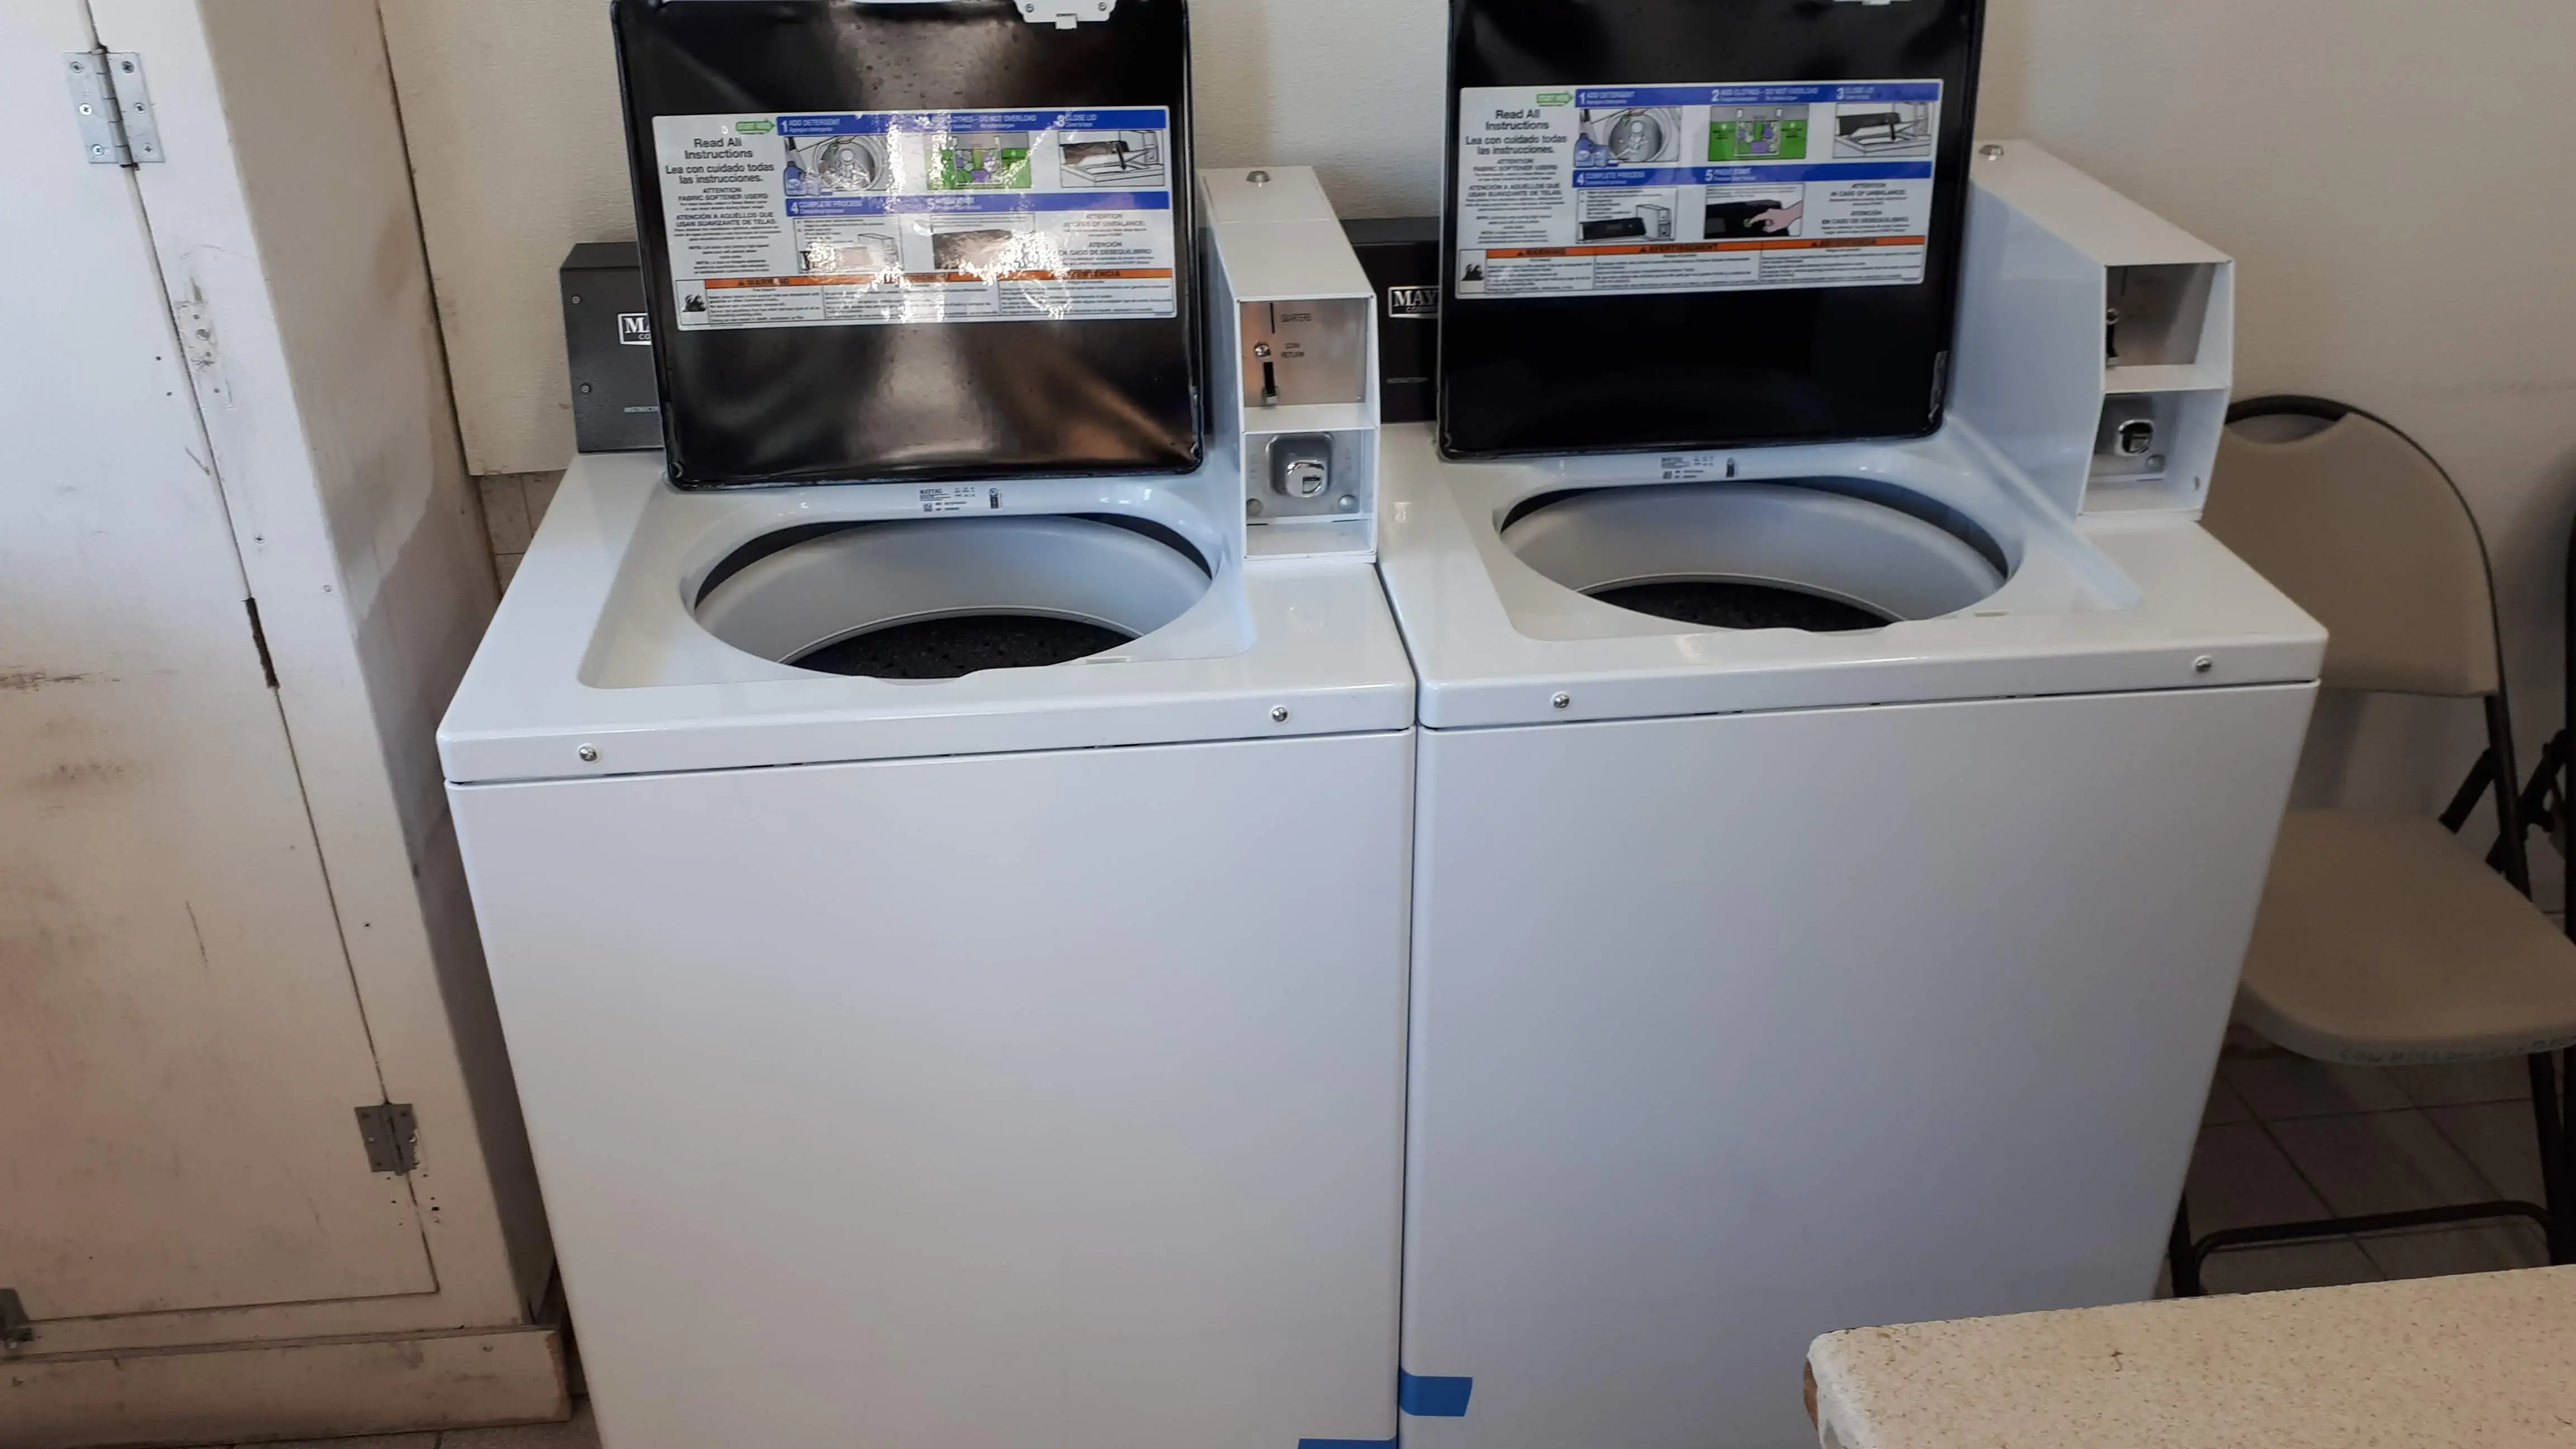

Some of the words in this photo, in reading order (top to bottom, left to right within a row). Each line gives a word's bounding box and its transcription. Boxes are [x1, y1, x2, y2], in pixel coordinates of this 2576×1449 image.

[1578, 91, 1585, 105] 1
[1712, 89, 1720, 102] 2
[1836, 87, 1844, 100] 3
[1495, 110, 1524, 119] Read
[1526, 109, 1541, 118] All
[780, 120, 788, 132] 1
[1485, 121, 1549, 130] Instructions
[694, 138, 724, 148] Read
[727, 137, 742, 146] All
[1465, 136, 1481, 145] Lea
[1504, 135, 1539, 144] cuidado
[1541, 135, 1568, 143] todas
[685, 149, 753, 159] Instructions
[665, 165, 683, 174] Lea
[686, 165, 704, 174] con
[706, 163, 746, 173] cuidado
[747, 162, 775, 172] todas
[679, 175, 694, 184] las
[695, 173, 764, 183] instrucciones.
[1576, 173, 1584, 186] 4
[1705, 169, 1713, 181] 5
[790, 201, 799, 214] 4
[927, 197, 935, 210] 5
